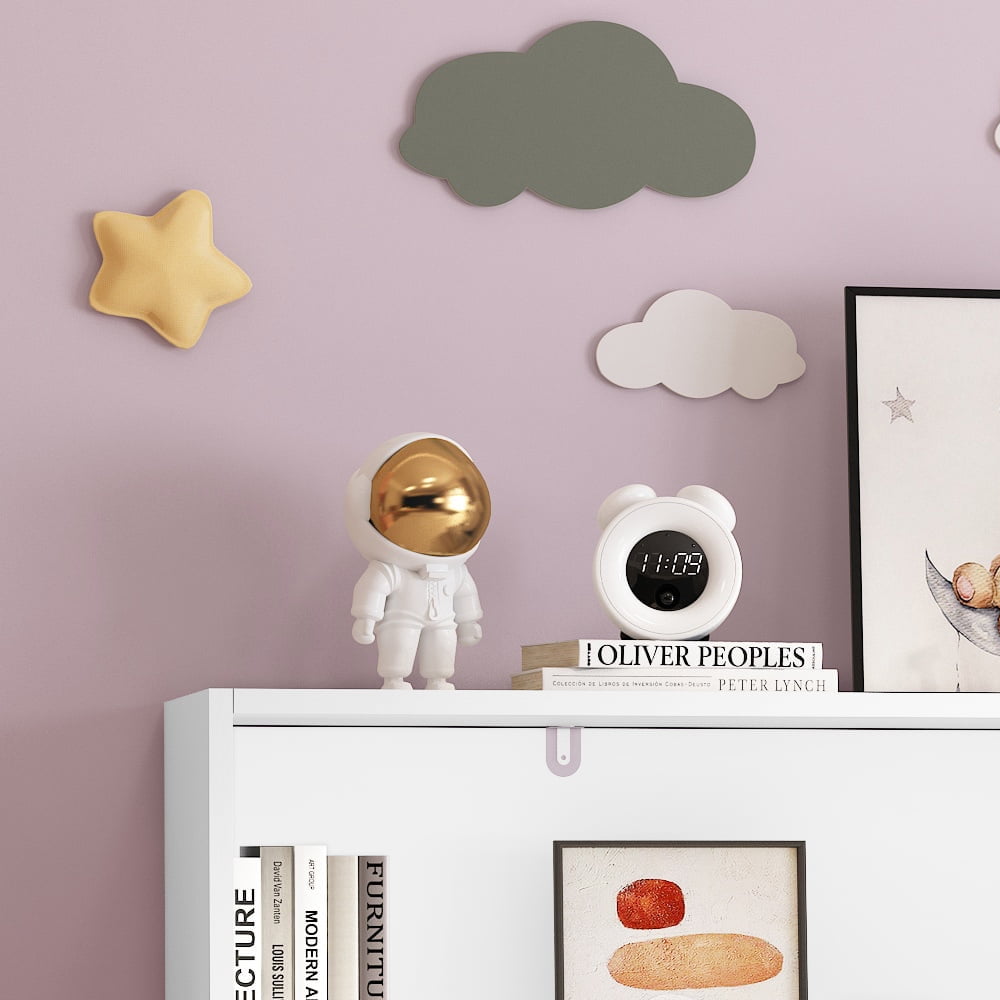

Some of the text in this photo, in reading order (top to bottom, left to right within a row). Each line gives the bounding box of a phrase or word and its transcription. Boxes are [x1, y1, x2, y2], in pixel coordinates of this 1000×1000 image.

[641, 552, 703, 576] 11:09
[597, 644, 691, 667] OLIVER
[698, 645, 806, 668] PEOPLES
[718, 678, 826, 692] PETER LYNCH
[273, 861, 283, 925] David Van Zanten
[271, 944, 284, 971] LOUIS
[304, 910, 319, 981] MODERN
